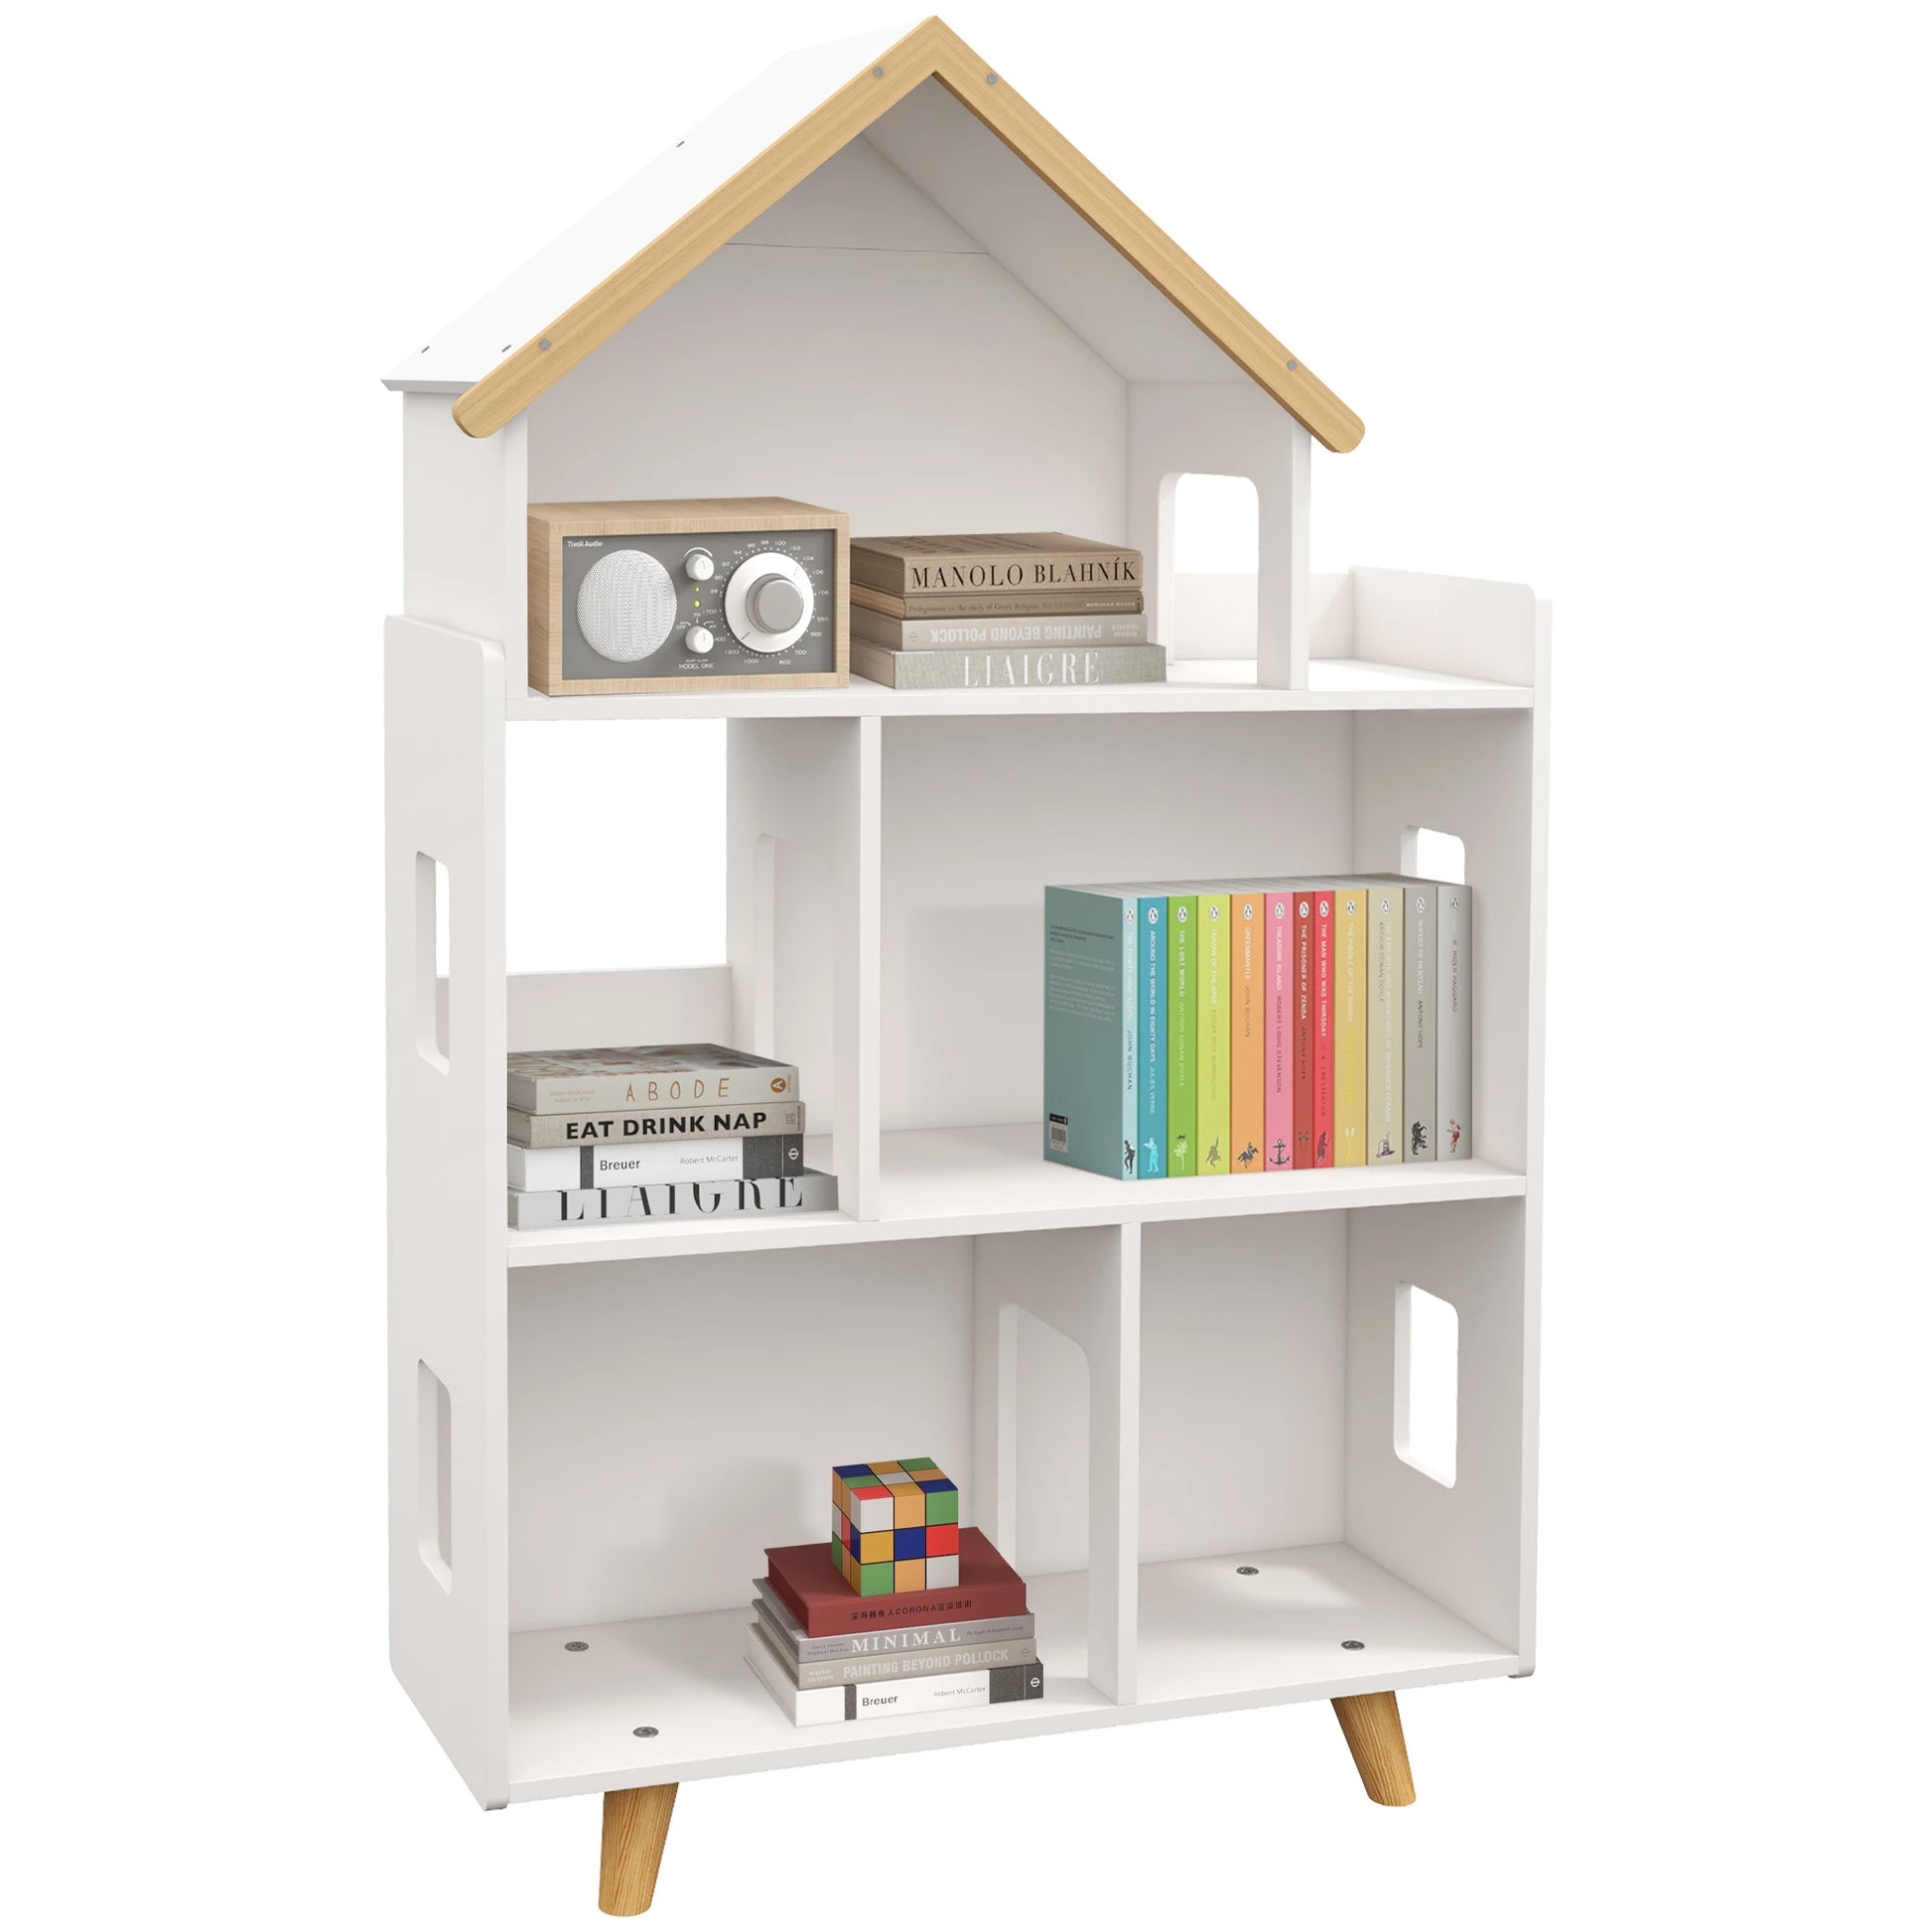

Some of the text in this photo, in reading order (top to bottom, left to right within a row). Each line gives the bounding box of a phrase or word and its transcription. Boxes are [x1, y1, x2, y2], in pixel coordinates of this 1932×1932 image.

[911, 557, 1137, 589] MANOLO BLAHNÍK
[930, 624, 1102, 644] PAINTING BEYOND POLLOCK
[964, 651, 1099, 687] LIAIGRE
[1347, 968, 1354, 979] OF
[1301, 982, 1308, 991] OF
[625, 1076, 730, 1102] ABODE
[566, 1112, 767, 1140] EAT DRINK NAP
[599, 1155, 739, 1171] Breuer Robert McCarter
[851, 1628, 961, 1653] MINIMAL
[843, 1649, 1009, 1679] PAINTING BEYOND POLLOCK
[862, 1695, 897, 1707] Breuer
